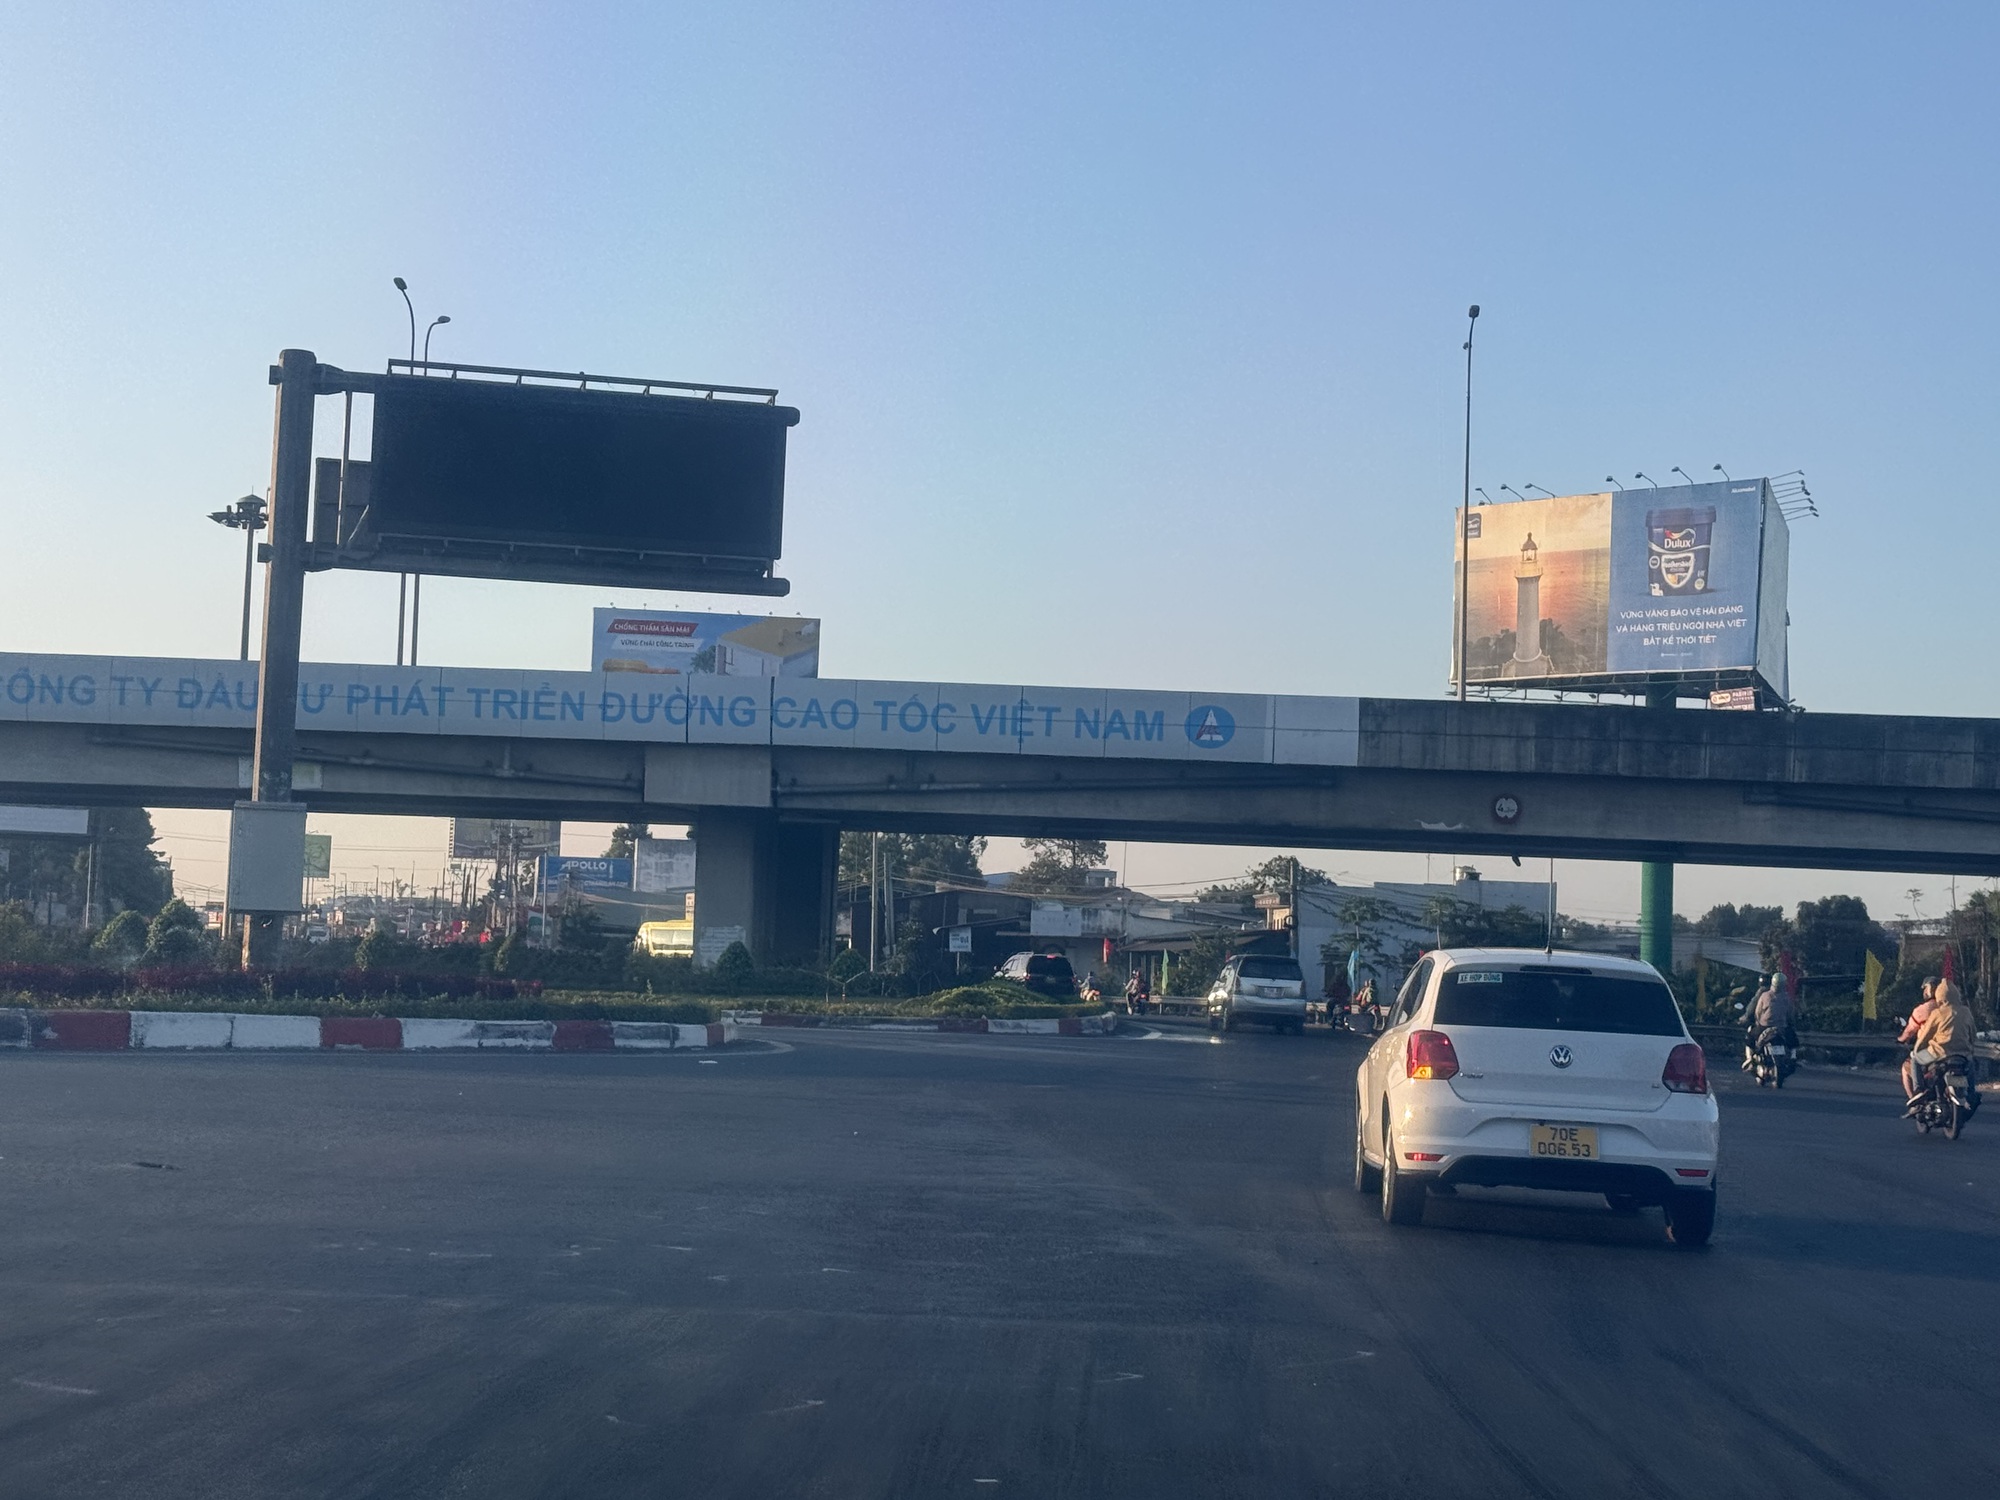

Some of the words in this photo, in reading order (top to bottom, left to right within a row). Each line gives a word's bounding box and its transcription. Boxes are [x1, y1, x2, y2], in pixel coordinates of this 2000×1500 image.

[1664, 538, 1691, 548] Dulux
[0, 666, 98, 706] ÔNG
[110, 675, 162, 706] TY
[299, 681, 335, 715] Ư
[346, 679, 456, 717] PHÁT
[598, 686, 757, 729] ĐƯỜNG
[772, 696, 860, 731] CAO
[874, 694, 957, 734] TỐC
[970, 699, 1062, 744] VIỆT
[1074, 707, 1165, 742] NAM
[560, 860, 608, 870] APOLLO
[1549, 1126, 1579, 1142] 70E
[1537, 1141, 1592, 1158] 006.53
